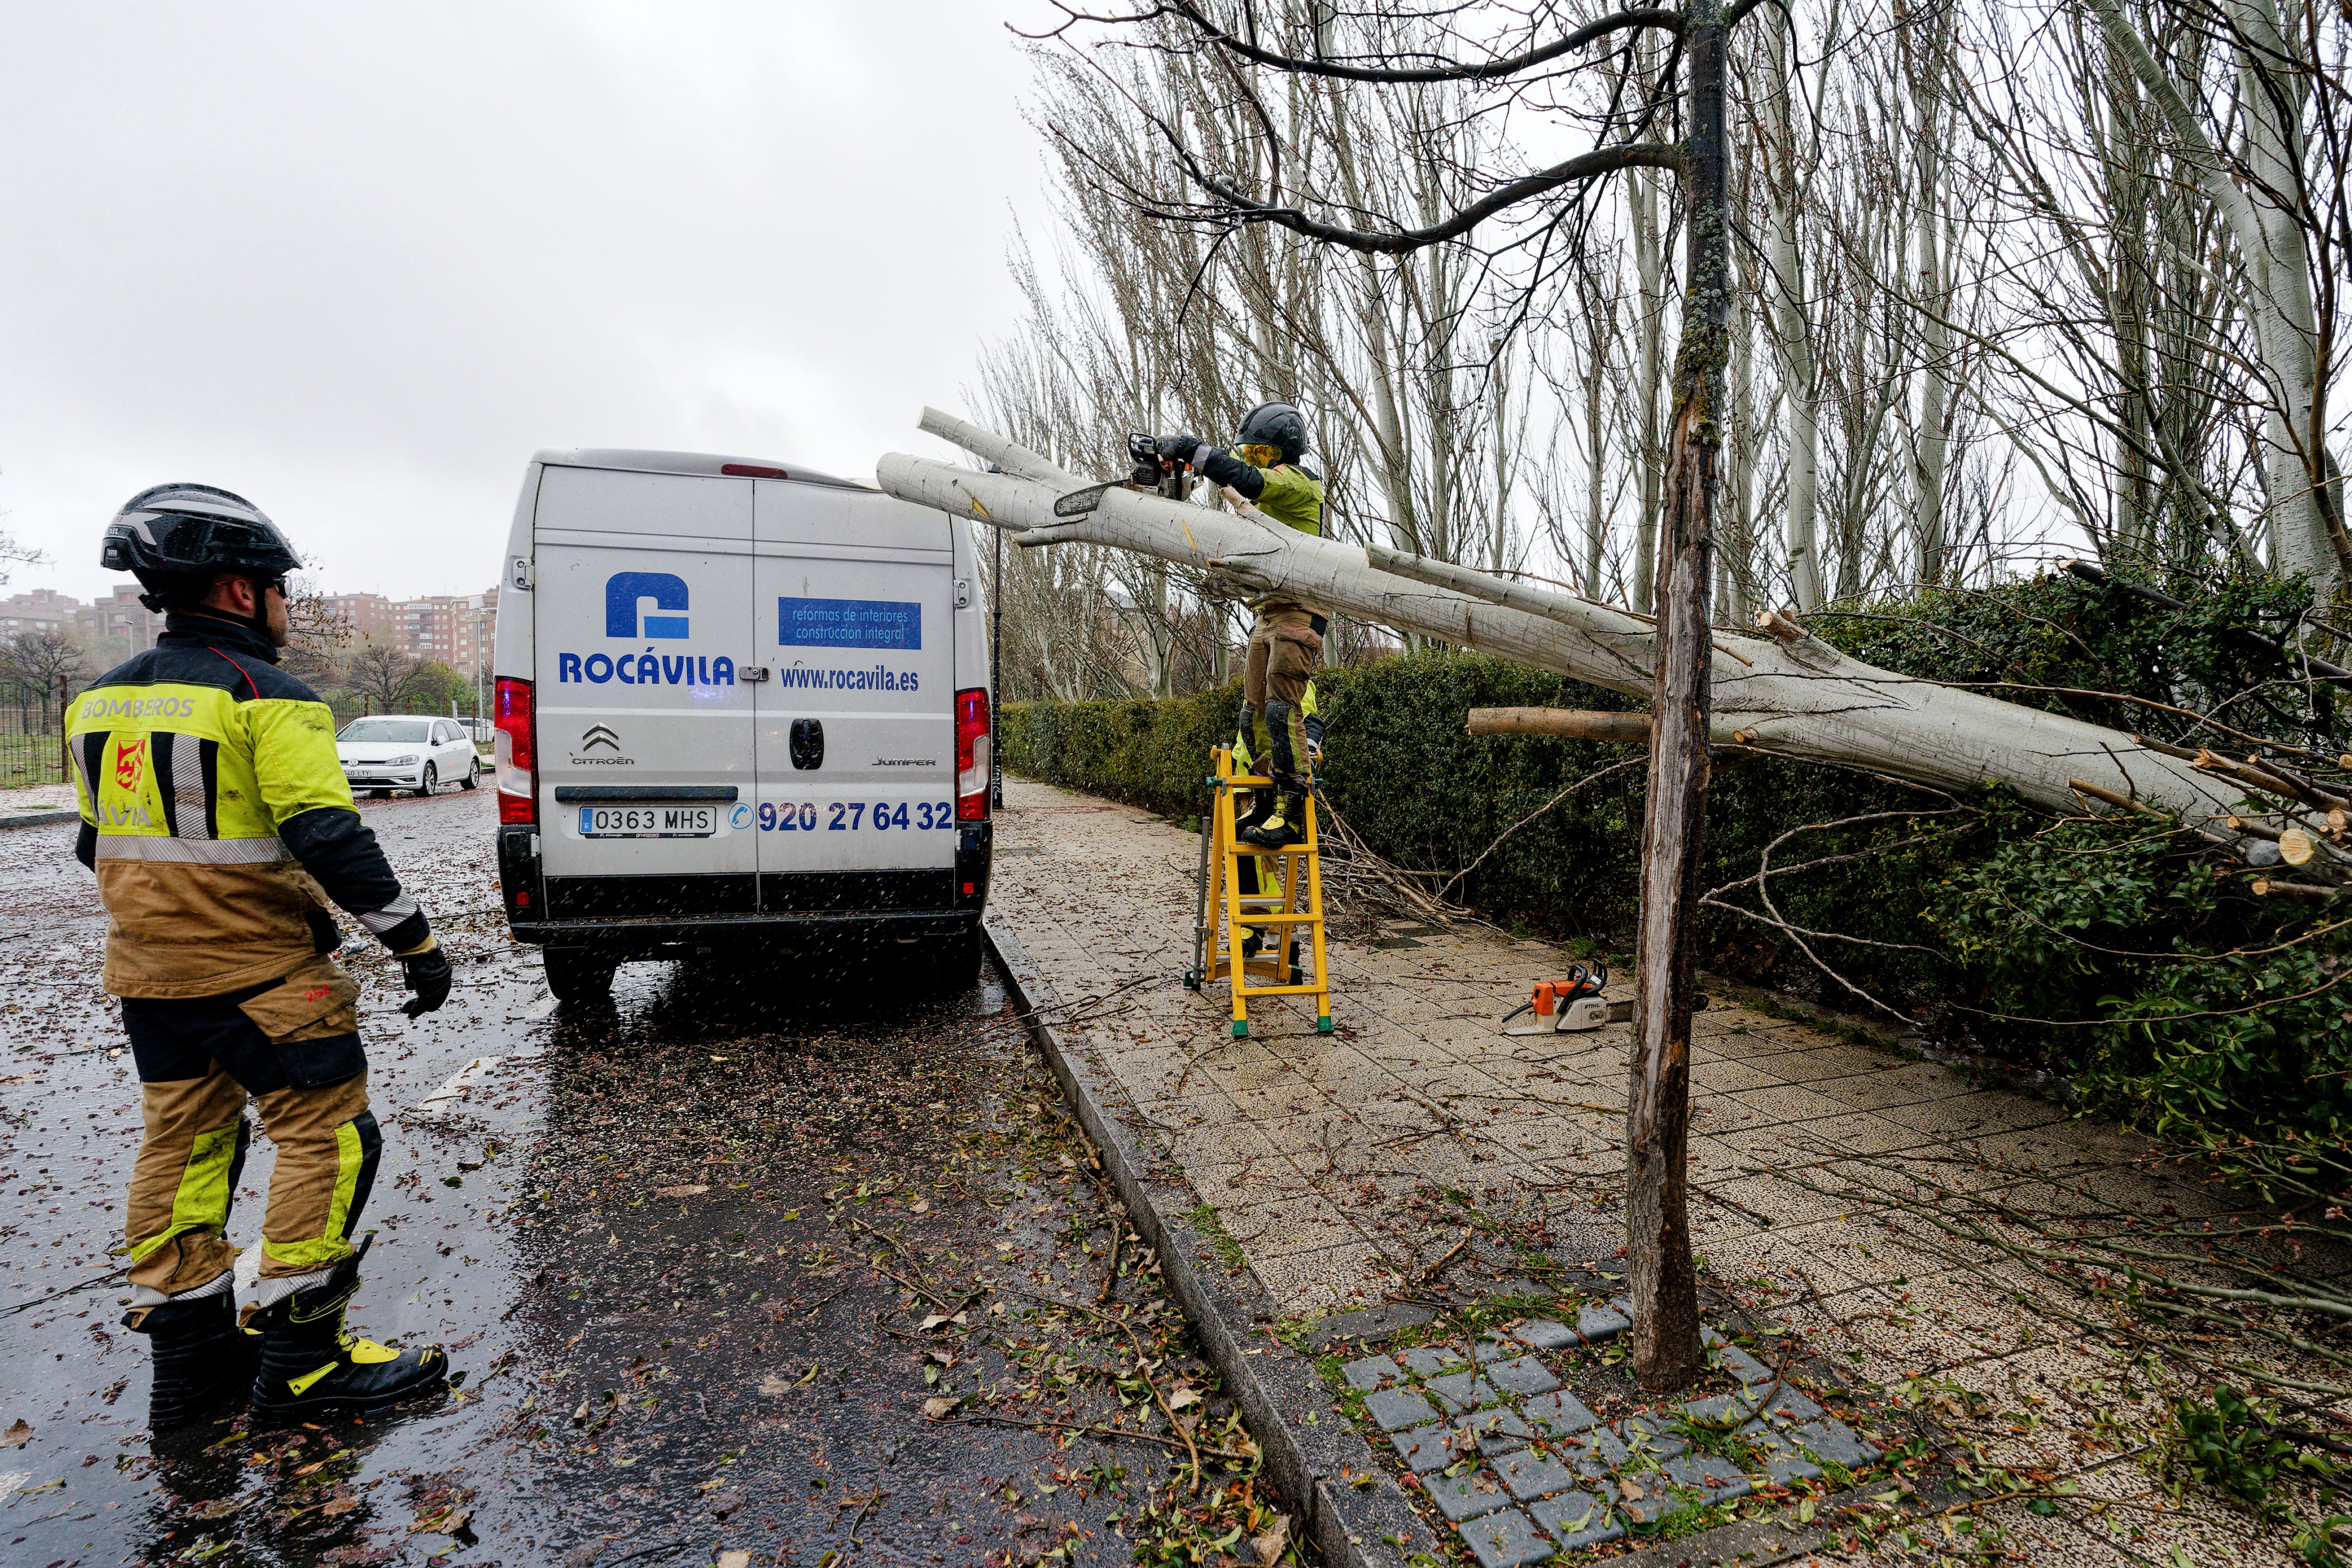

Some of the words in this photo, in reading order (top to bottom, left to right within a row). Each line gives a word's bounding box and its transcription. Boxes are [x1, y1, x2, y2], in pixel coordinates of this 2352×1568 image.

[792, 605, 840, 621] reformas
[843, 606, 857, 621] de
[859, 607, 908, 623] interiores
[796, 624, 862, 639] construcción
[865, 624, 904, 644] integral
[559, 646, 735, 685] ROCÁVILA
[781, 665, 918, 691] www.rocavila.es
[81, 697, 195, 719] BOMBEROS
[596, 811, 655, 829] 0363
[665, 810, 708, 829] MHS
[758, 802, 817, 831] 920
[828, 802, 866, 831] 27
[873, 802, 910, 830] 64
[916, 802, 953, 829] 32
[303, 984, 332, 1003] 252
